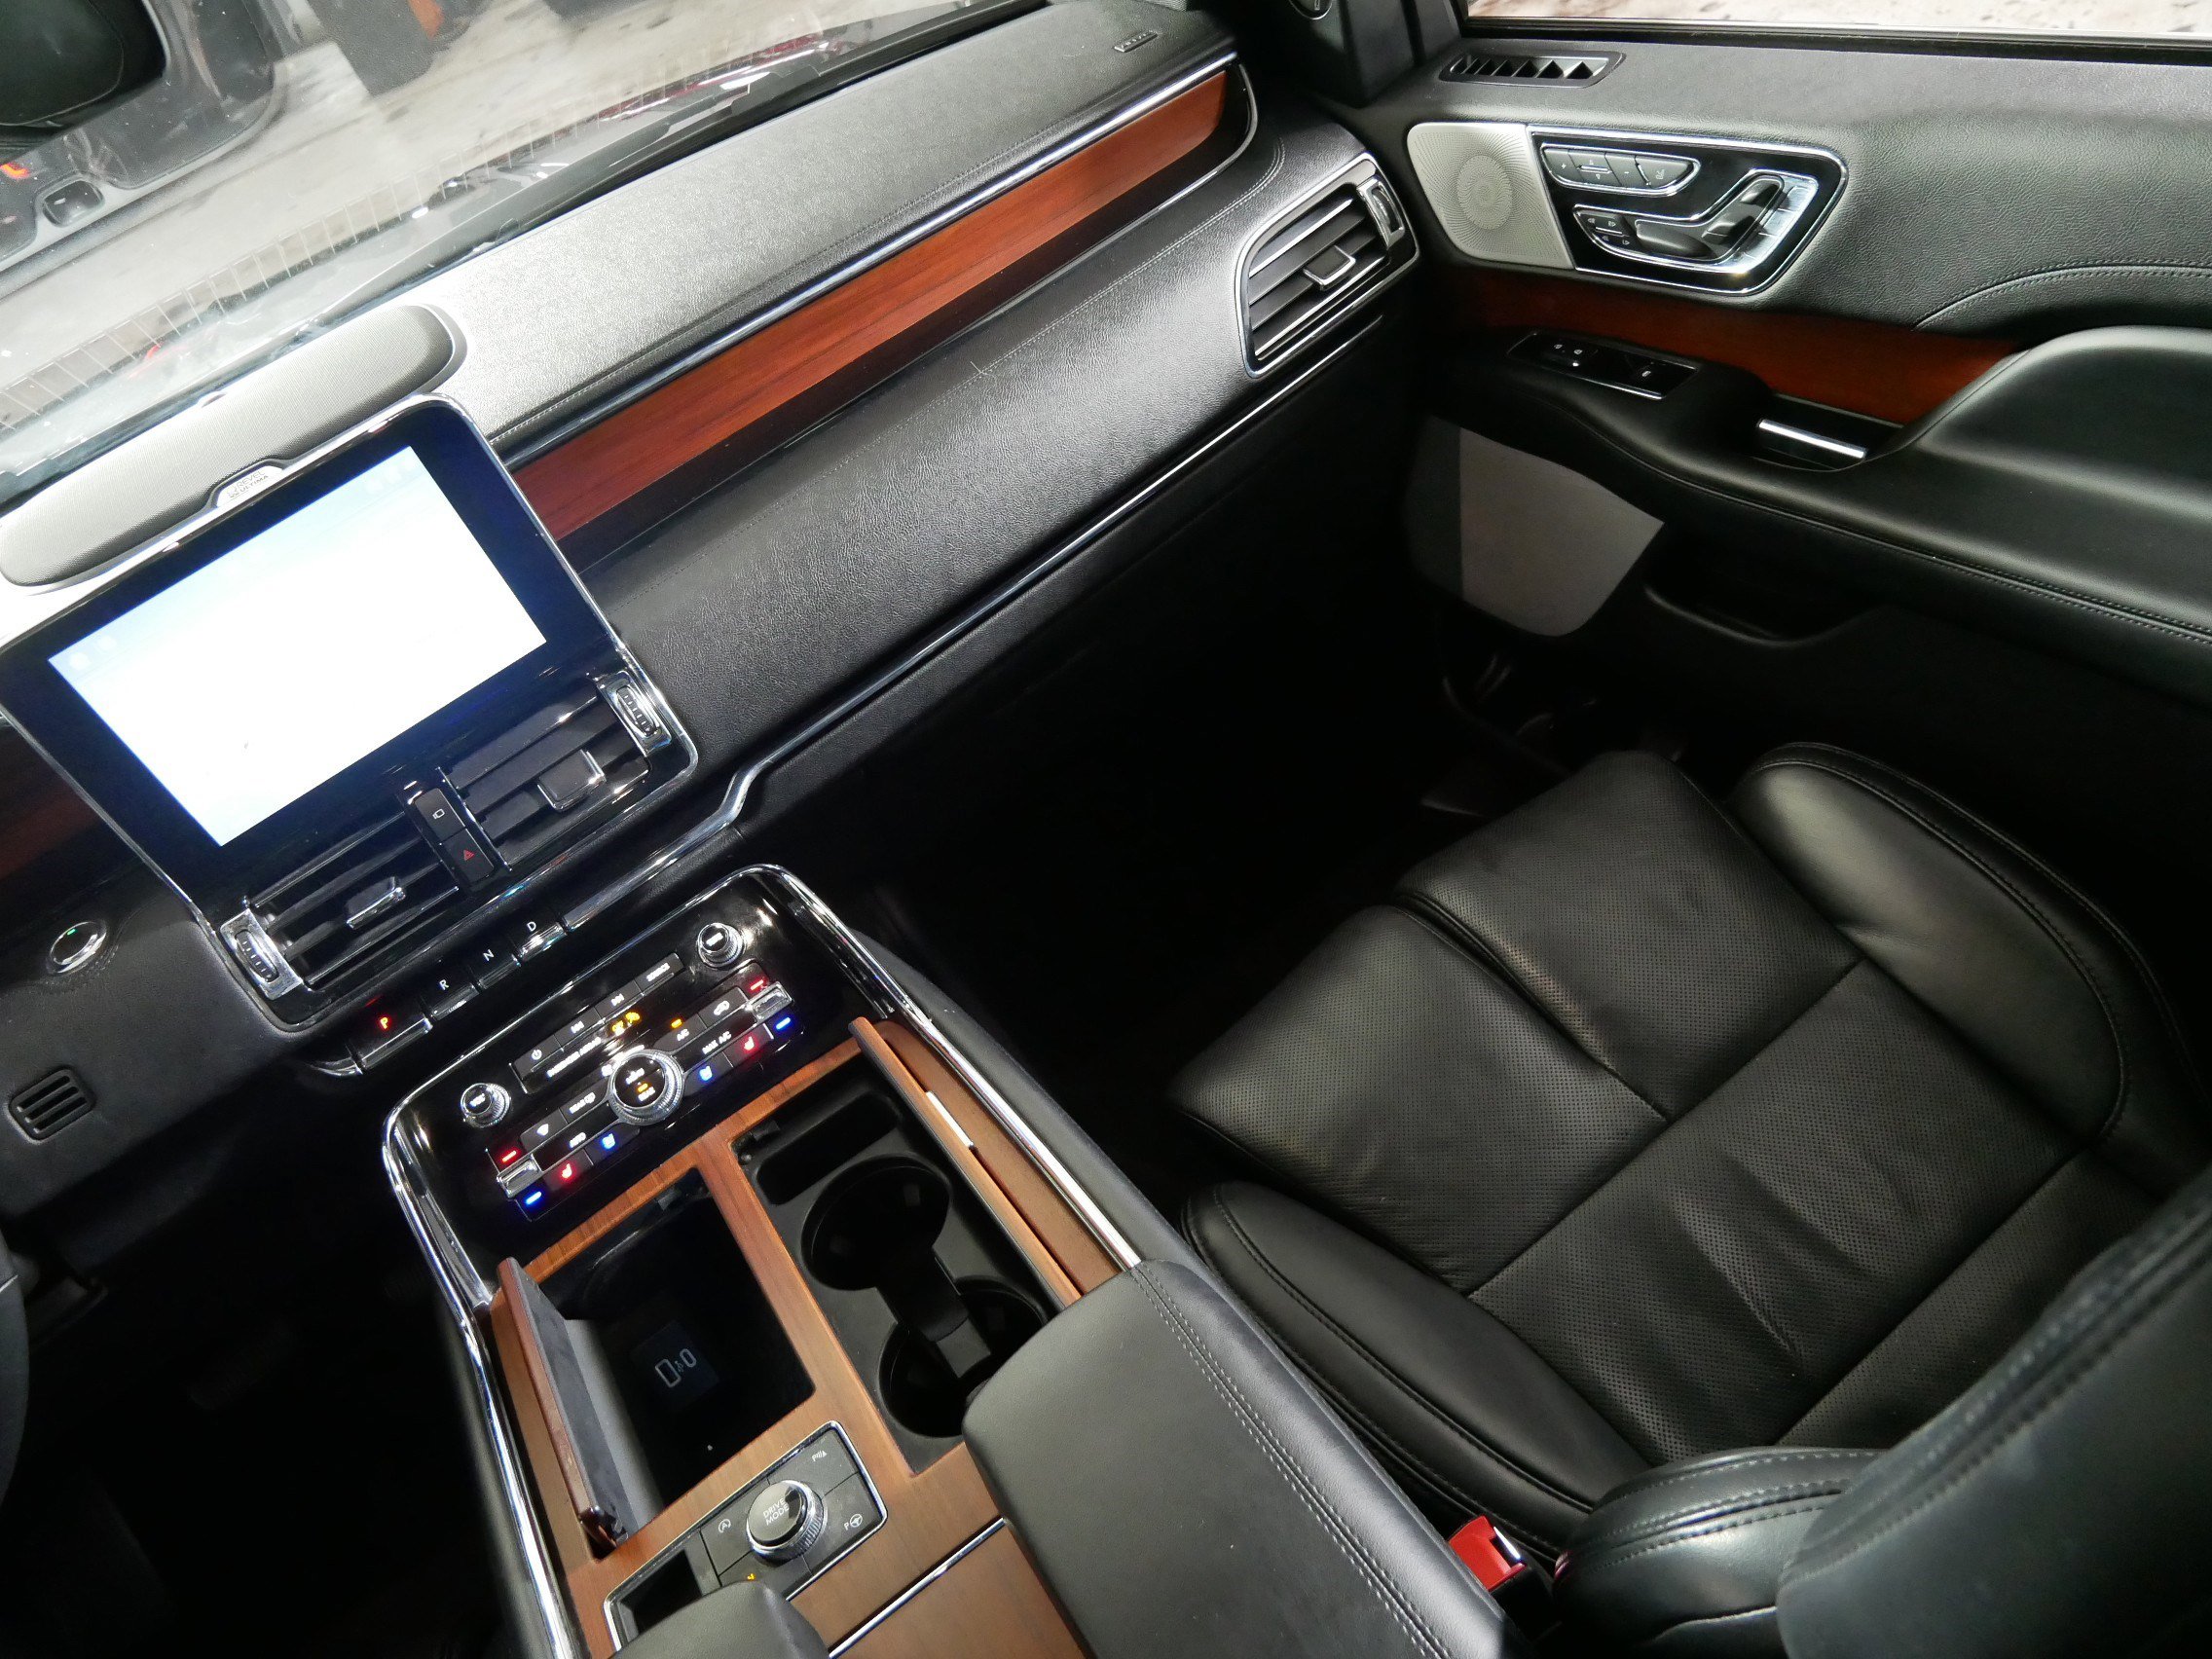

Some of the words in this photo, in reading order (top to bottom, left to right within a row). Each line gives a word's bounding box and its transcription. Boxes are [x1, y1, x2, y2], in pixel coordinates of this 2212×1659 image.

[237, 470, 266, 487] REVEL
[240, 475, 269, 493] ULTIMA
[527, 921, 536, 932] D
[483, 949, 495, 961] N
[439, 979, 449, 990] R
[380, 1016, 388, 1030] P
[677, 1028, 689, 1041] A/C
[719, 1030, 732, 1044] A/C
[762, 1497, 786, 1519] DRIVE
[765, 1504, 790, 1526] MODE
